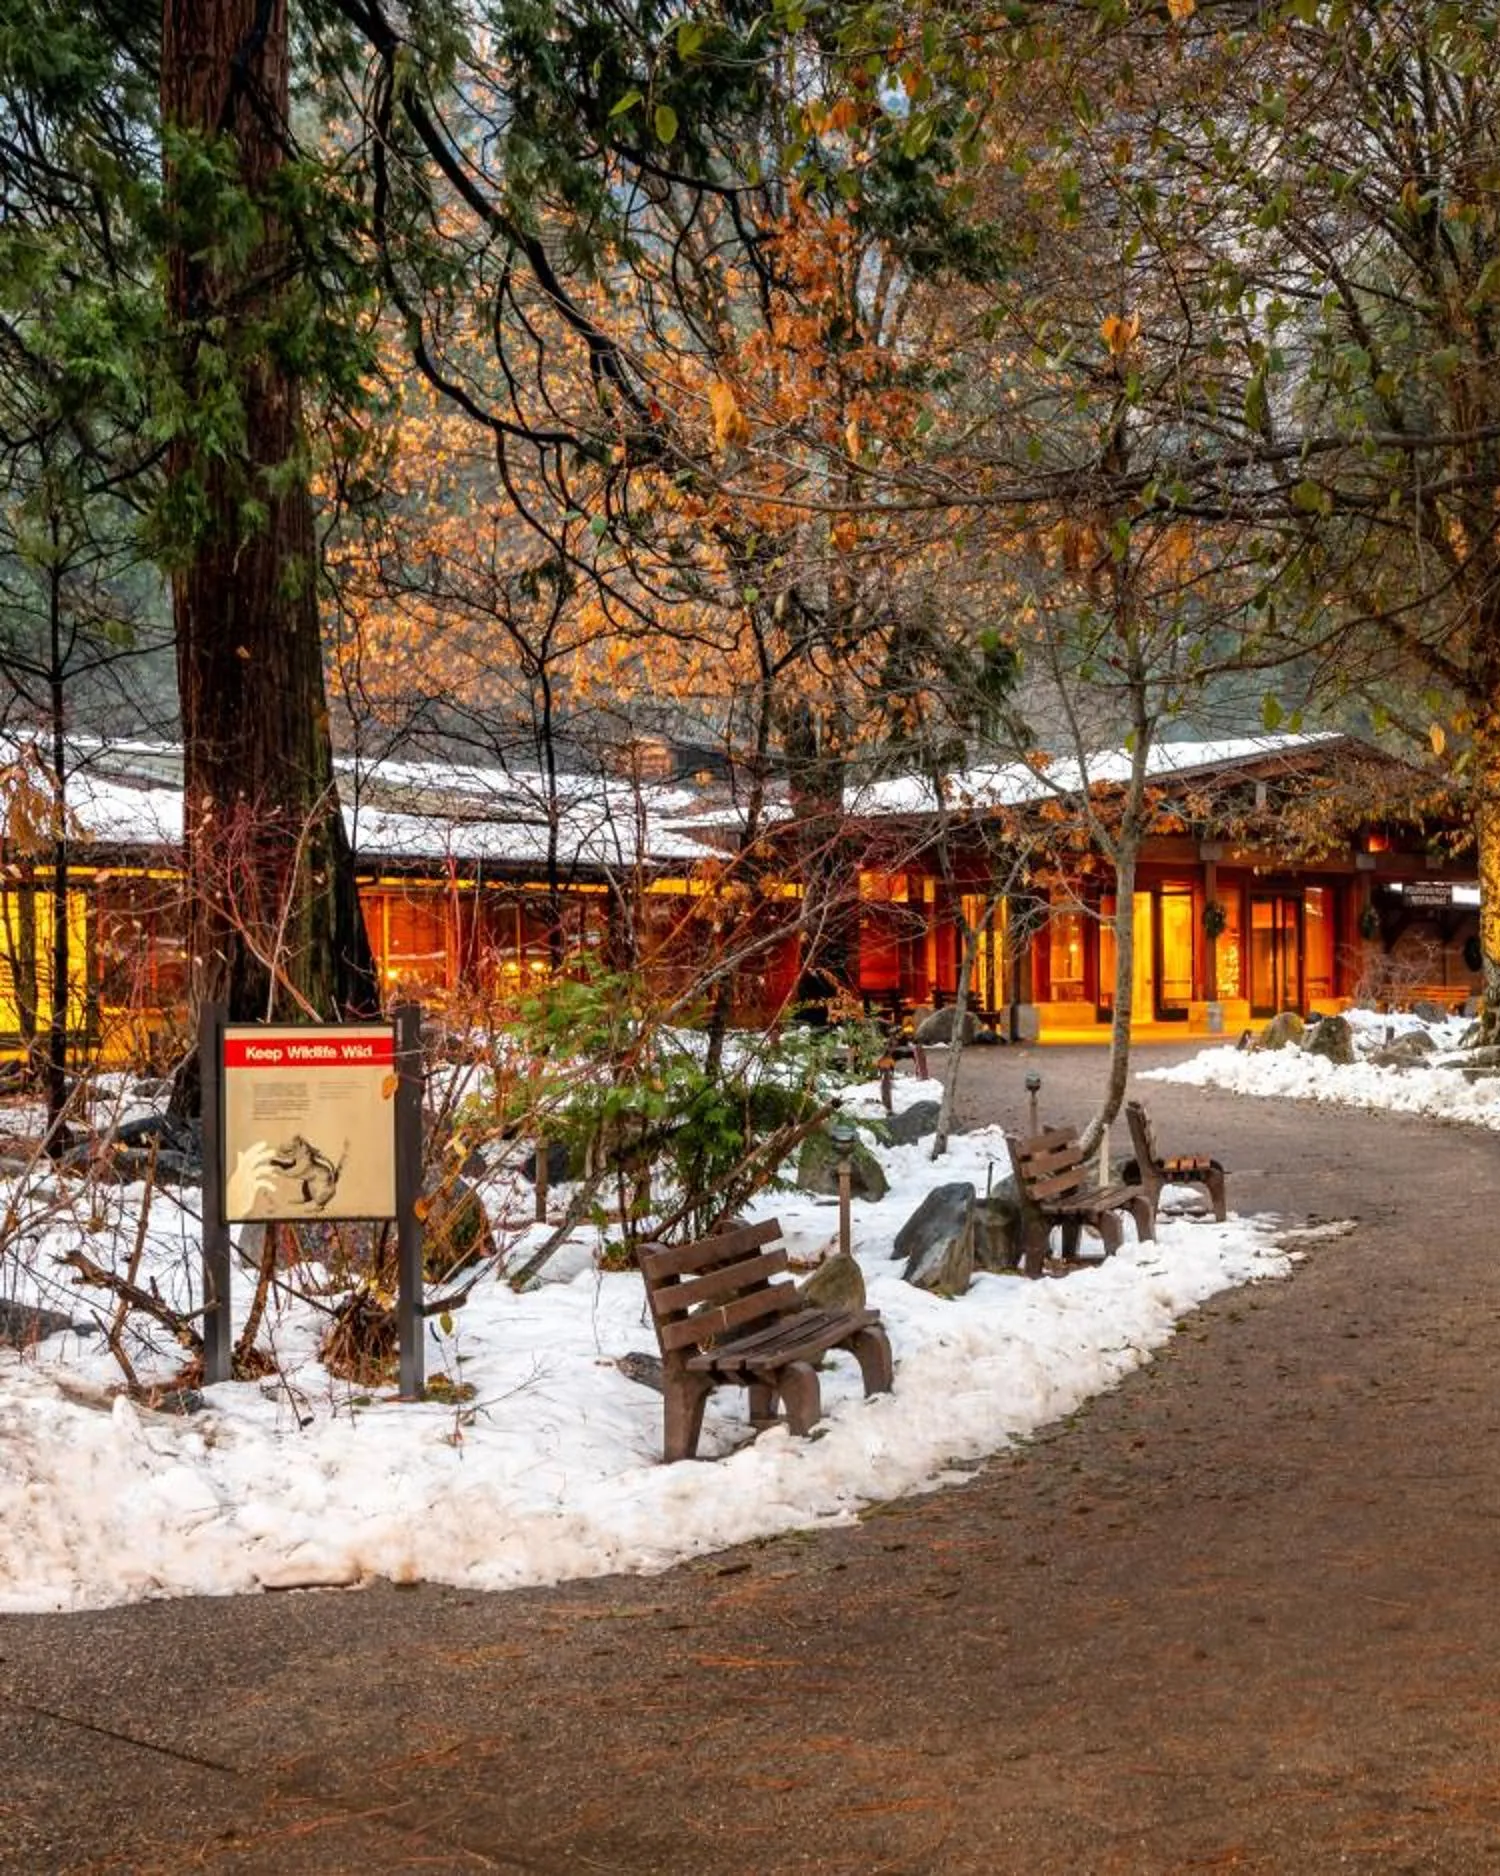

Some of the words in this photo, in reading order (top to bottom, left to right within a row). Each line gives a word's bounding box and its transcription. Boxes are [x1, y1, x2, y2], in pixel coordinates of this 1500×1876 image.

[245, 1045, 283, 1063] Keep
[287, 1045, 337, 1059] Wildlife
[341, 1044, 373, 1059] Wild
